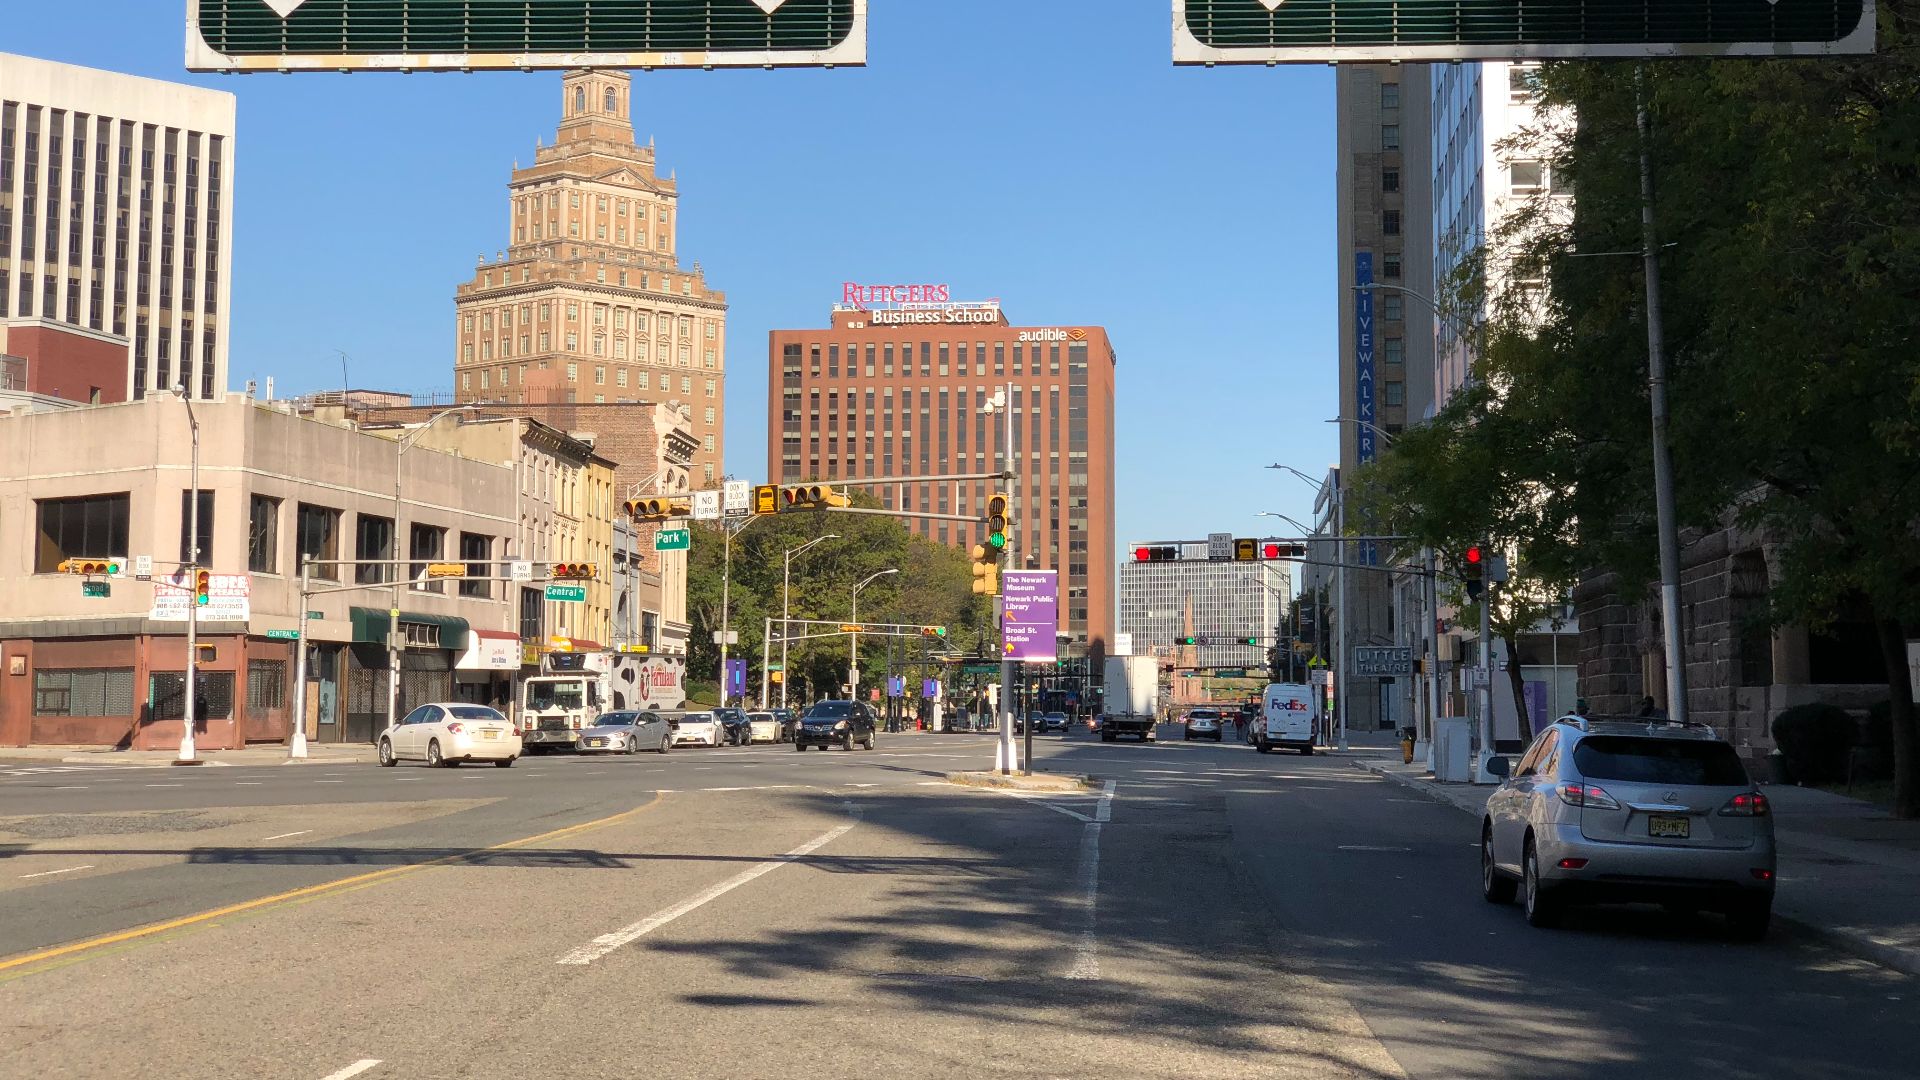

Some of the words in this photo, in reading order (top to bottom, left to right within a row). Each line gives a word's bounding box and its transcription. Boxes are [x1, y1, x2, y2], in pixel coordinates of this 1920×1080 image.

[872, 309, 941, 323] Business
[945, 308, 998, 323] School
[1018, 328, 1067, 341] audible
[729, 491, 745, 499] BLOCK
[738, 500, 748, 508] BOX
[697, 506, 718, 515] TURNS
[656, 532, 679, 543] Park
[546, 586, 577, 597] Central
[1005, 602, 1030, 611] Library
[1359, 650, 1409, 661] LITTLE
[1360, 663, 1409, 672] THEATRE
[1272, 698, 1307, 711] FedEx
